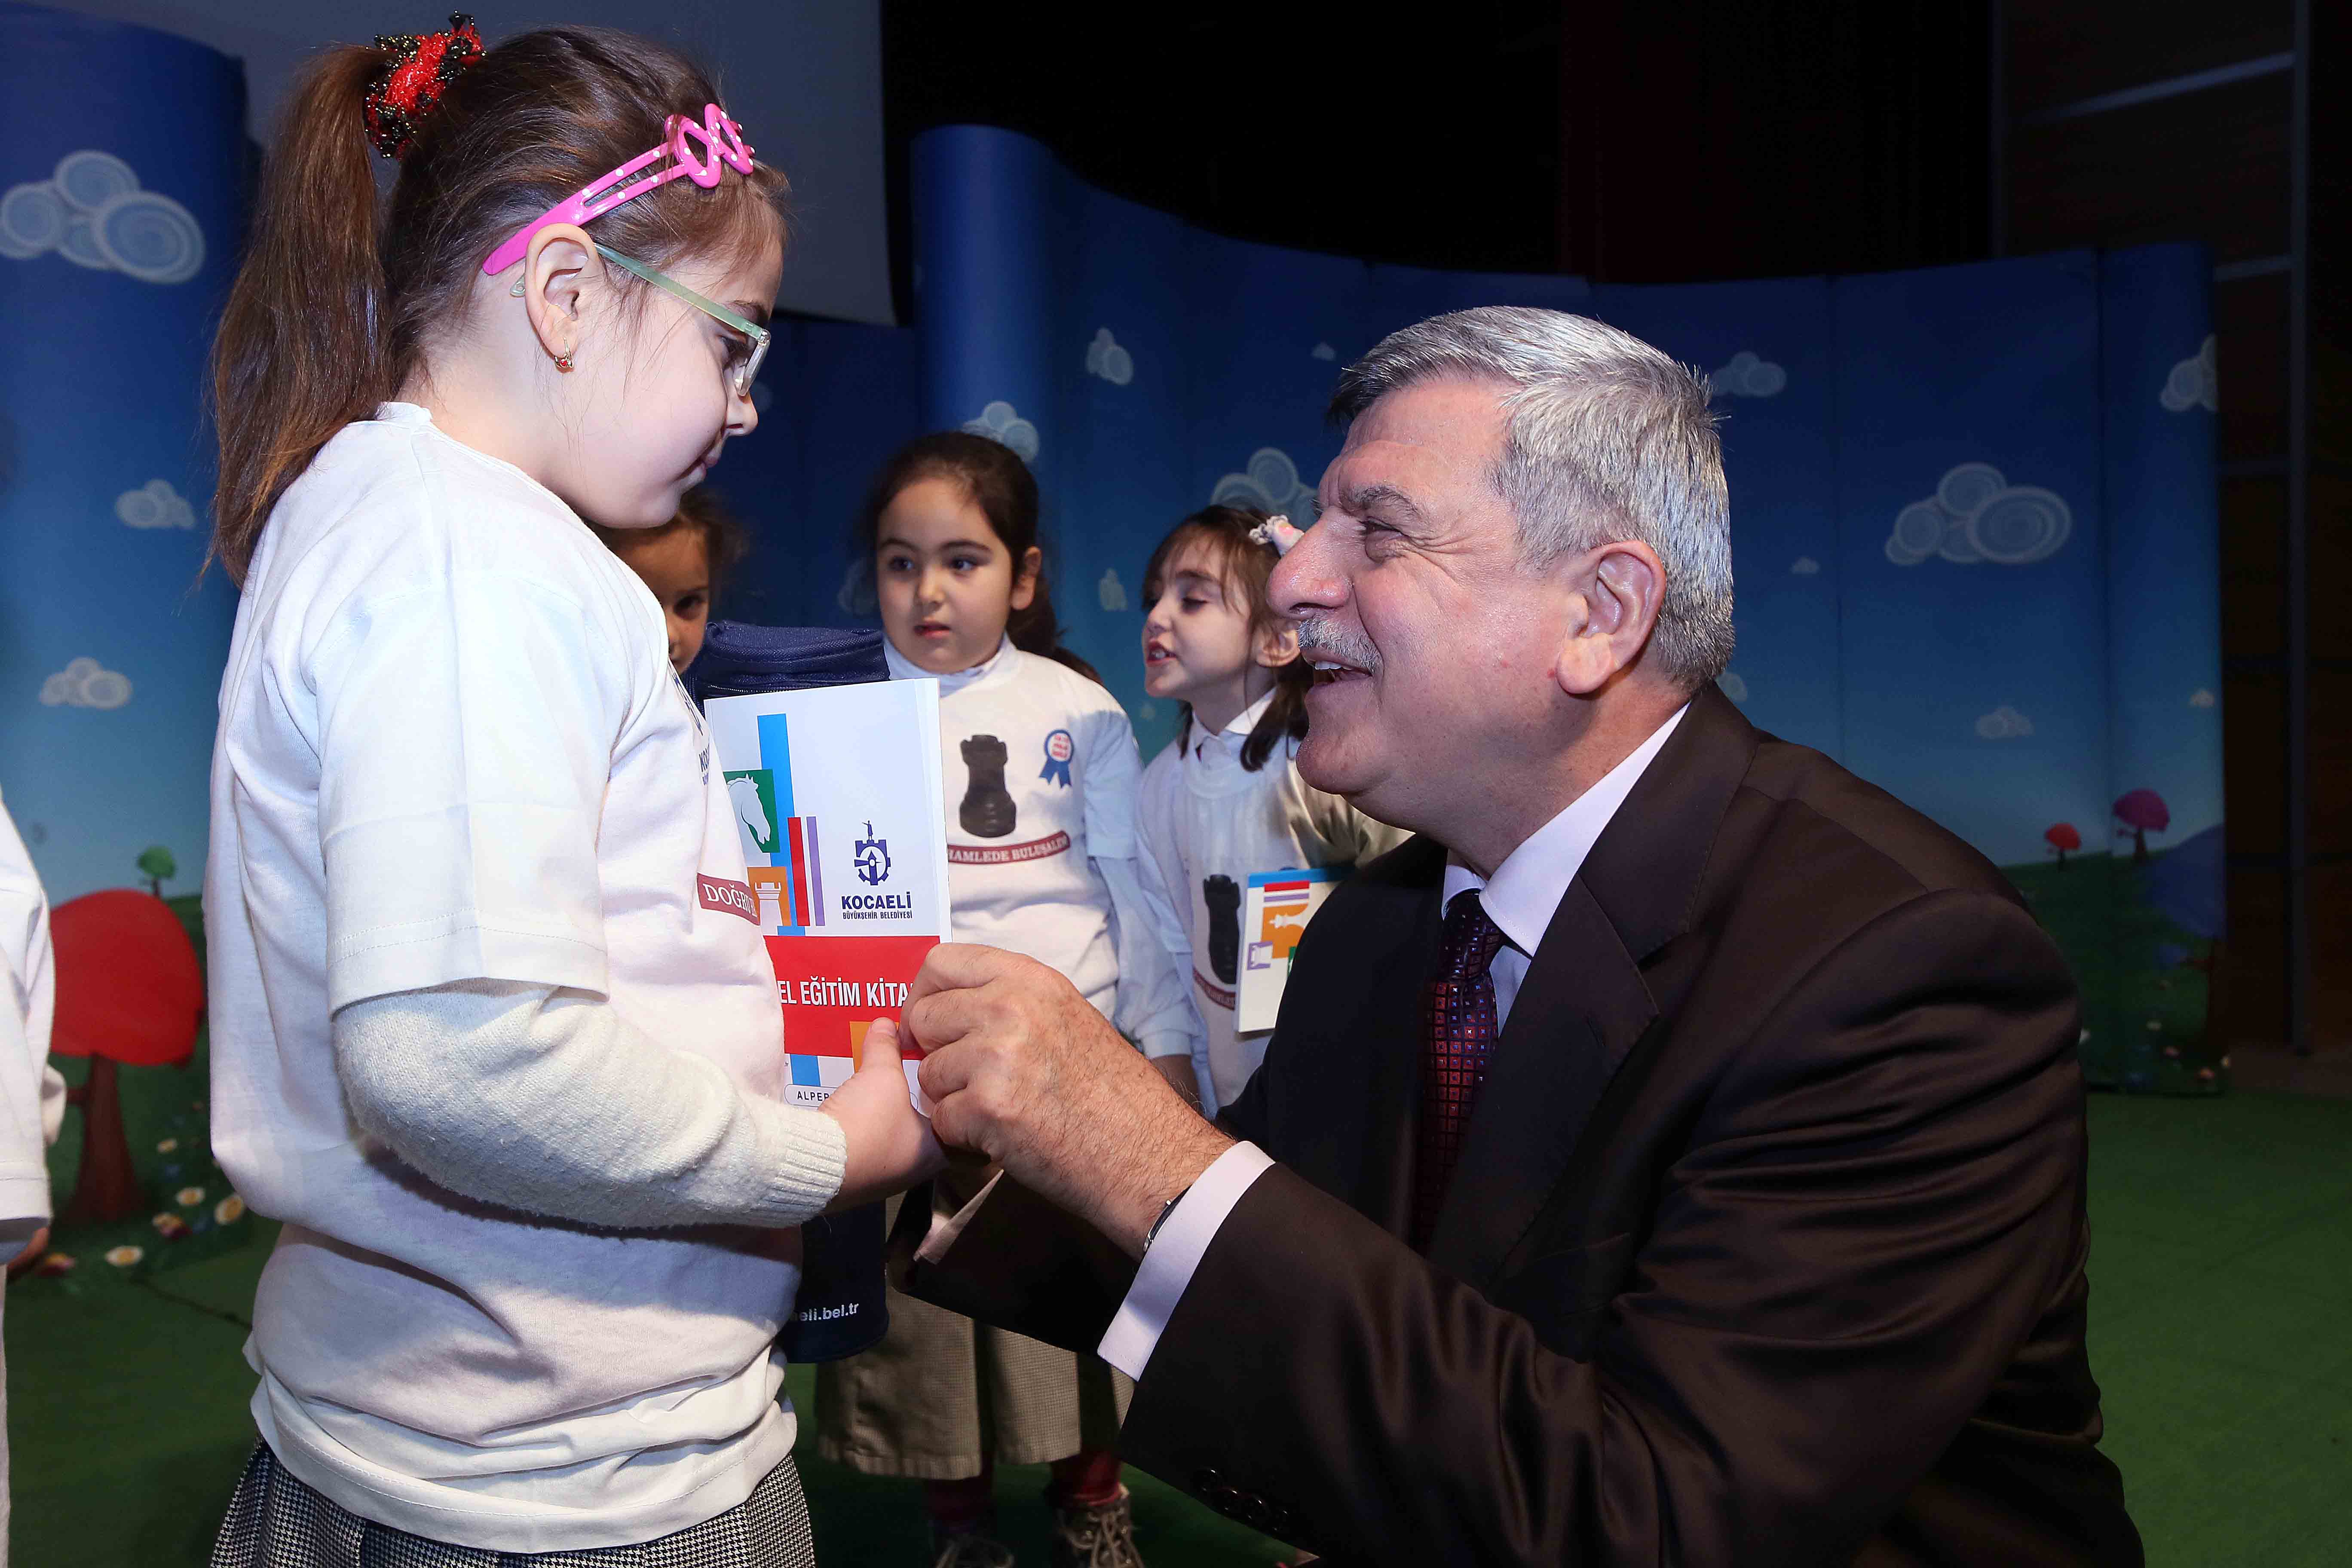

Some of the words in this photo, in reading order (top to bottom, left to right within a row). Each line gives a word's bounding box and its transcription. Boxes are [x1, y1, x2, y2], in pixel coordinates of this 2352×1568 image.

[841, 891, 912, 910] KOCAELİ
[842, 910, 877, 920] BÜYÜKŞEHİR
[880, 910, 913, 919] BELEDİYESİ
[800, 976, 861, 1006] EĞİTİM
[866, 977, 913, 1007] KİTA
